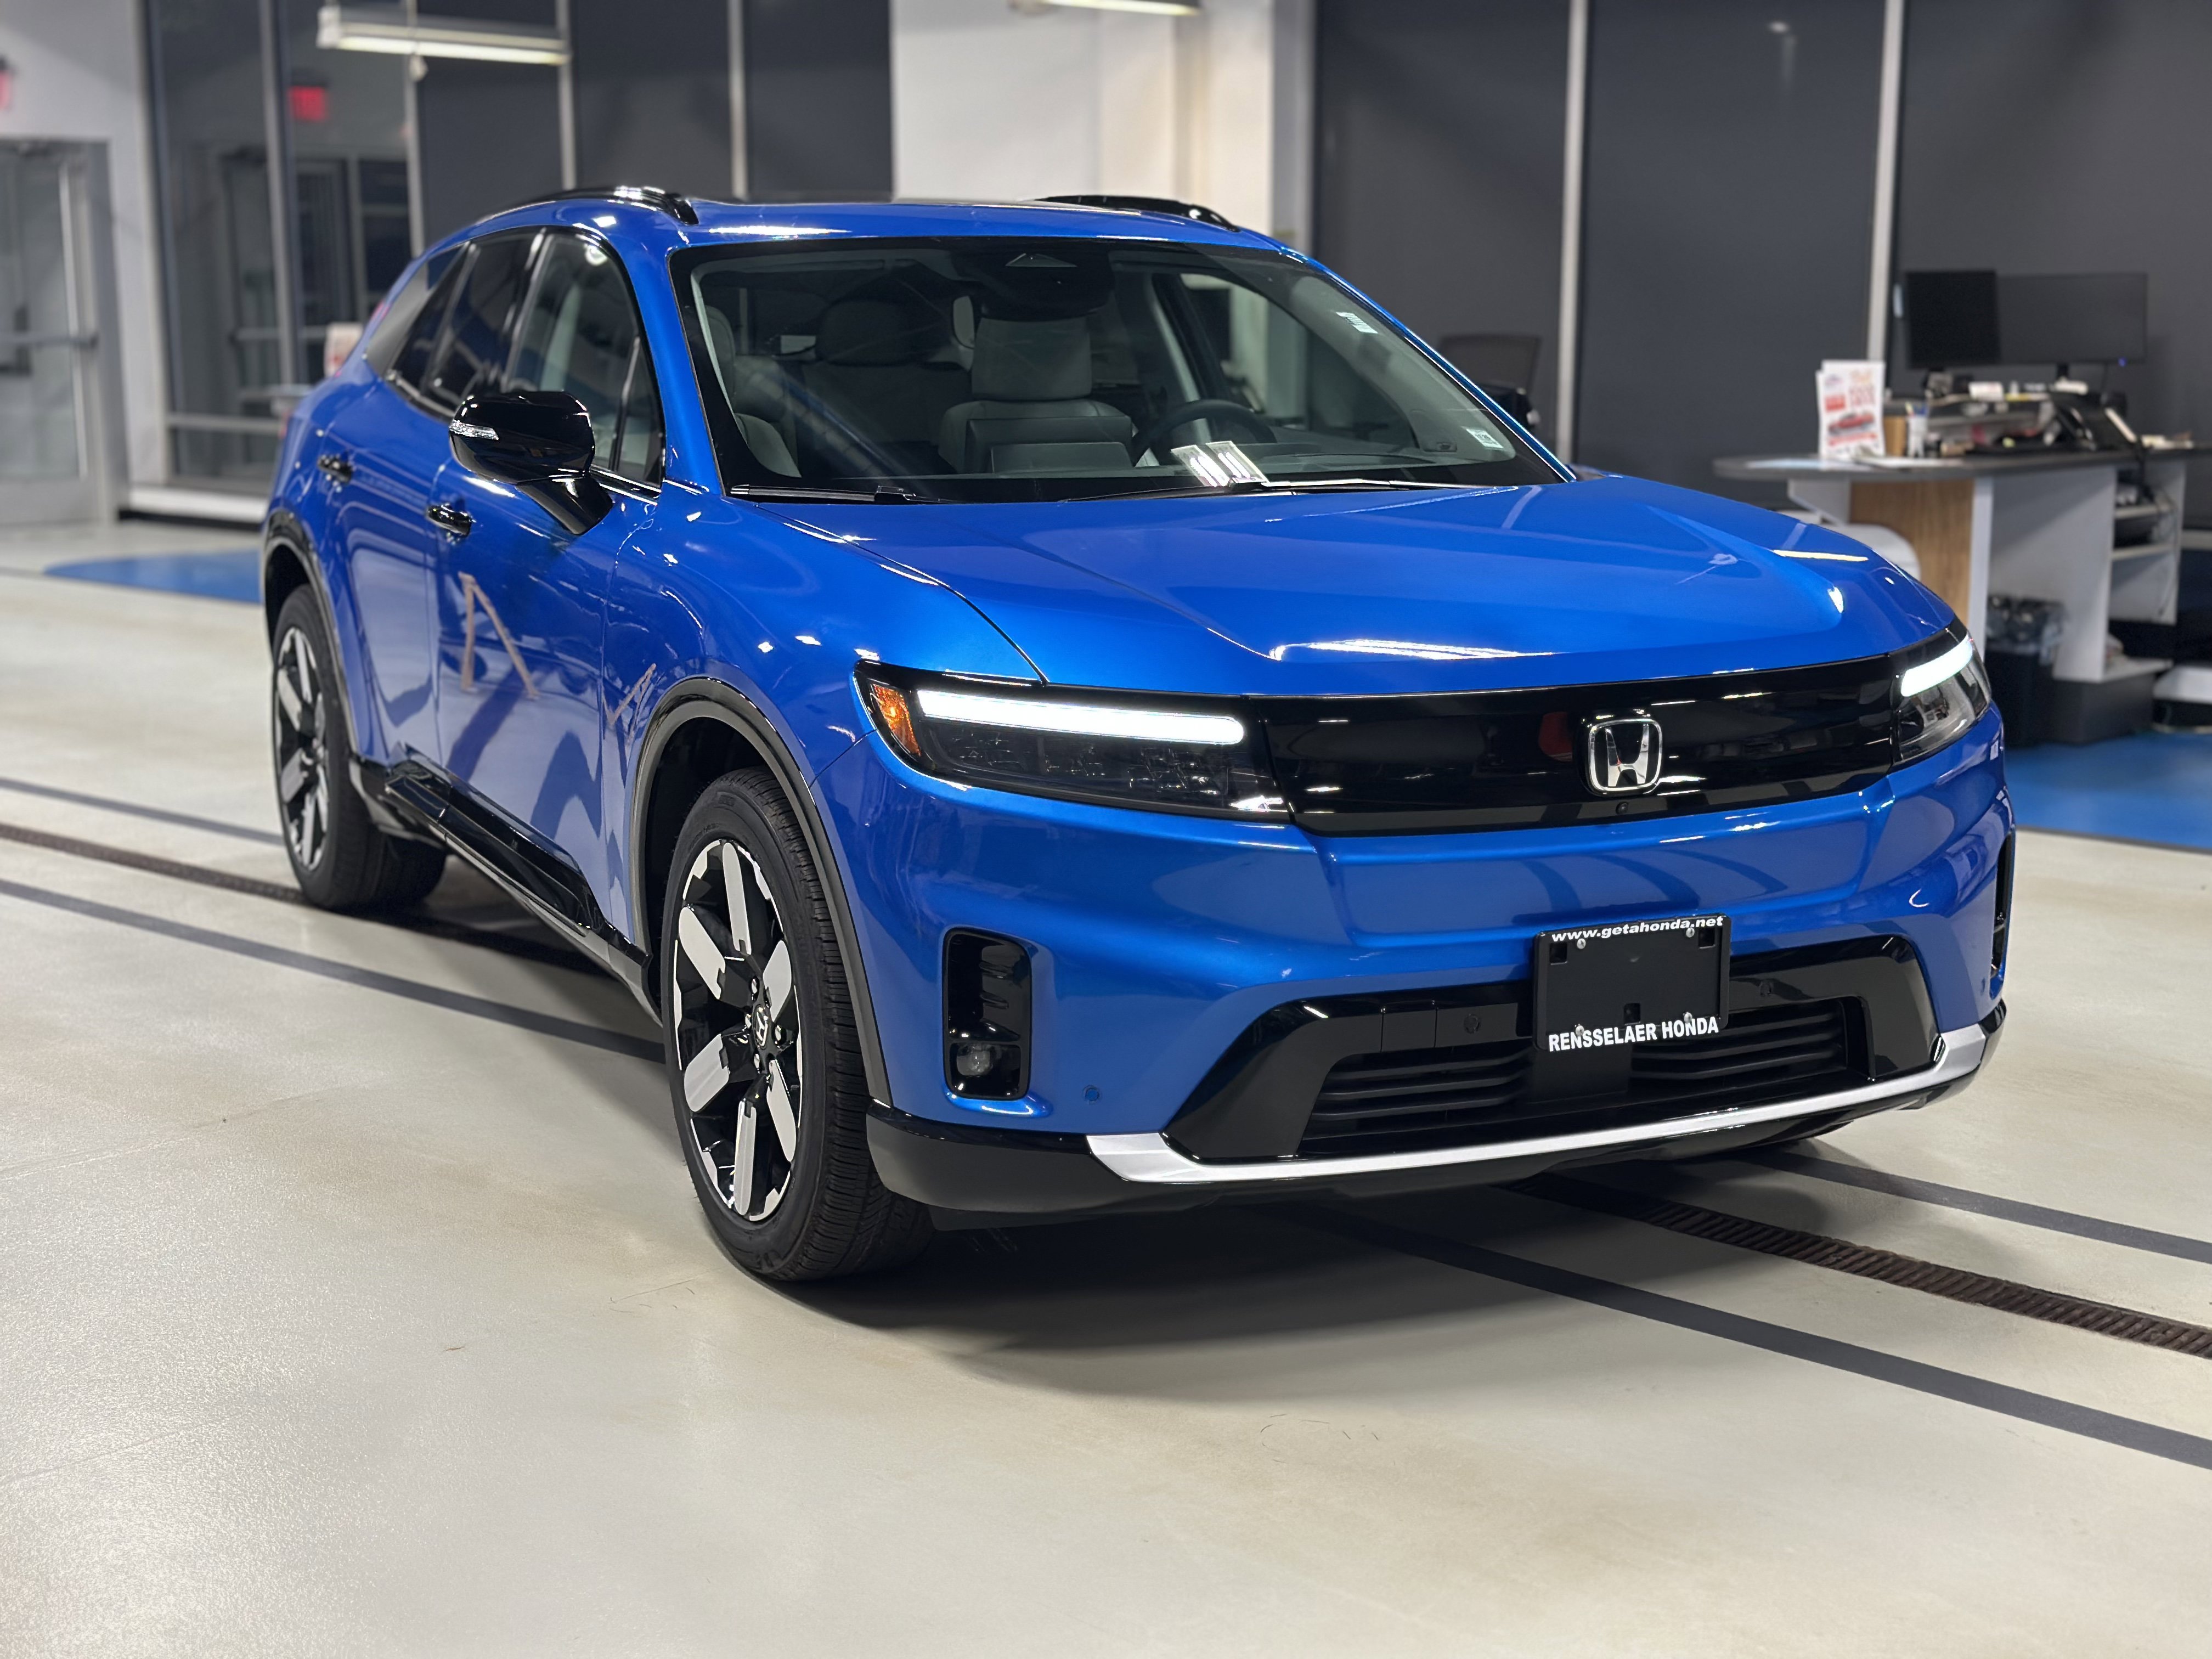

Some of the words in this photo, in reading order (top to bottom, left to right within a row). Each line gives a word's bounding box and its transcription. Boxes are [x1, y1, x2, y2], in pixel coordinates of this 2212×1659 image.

[1551, 916, 1724, 942] www.getahonda.net
[1549, 1023, 1657, 1052] RENSSELAER
[1661, 1016, 1719, 1040] HONDA
